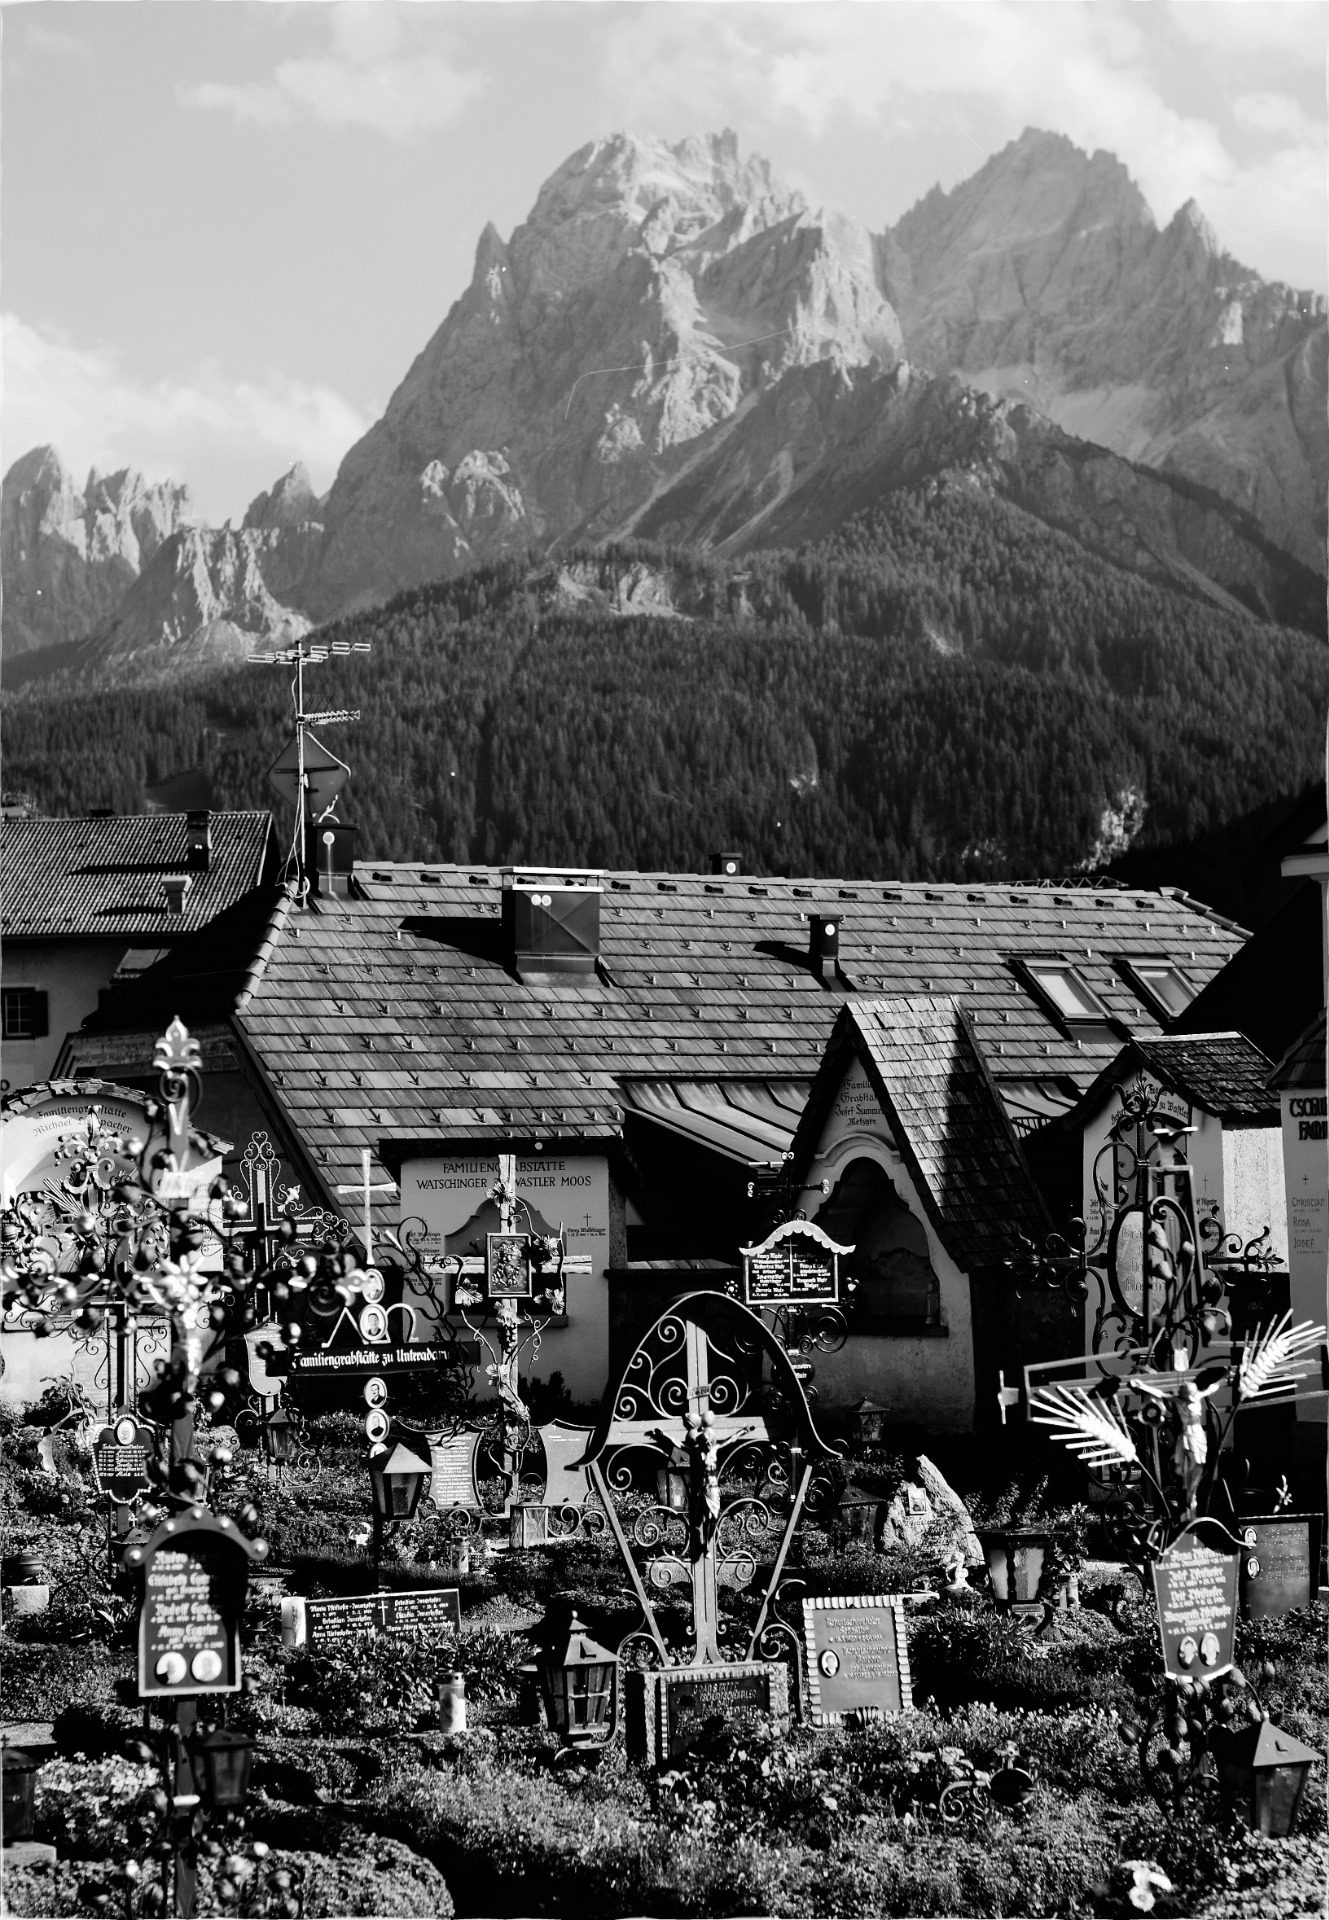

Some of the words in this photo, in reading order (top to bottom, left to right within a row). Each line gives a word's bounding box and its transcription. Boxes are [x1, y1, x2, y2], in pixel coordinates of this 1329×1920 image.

[841, 1078, 871, 1090] Famili
[36, 1105, 127, 1120] Familiengrstätte
[443, 1161, 565, 1174] FAMILIENGABSTÄTTE
[416, 1178, 487, 1190] WATSCHINGER
[560, 1175, 592, 1187] MOOS
[381, 1352, 394, 1366] zu
